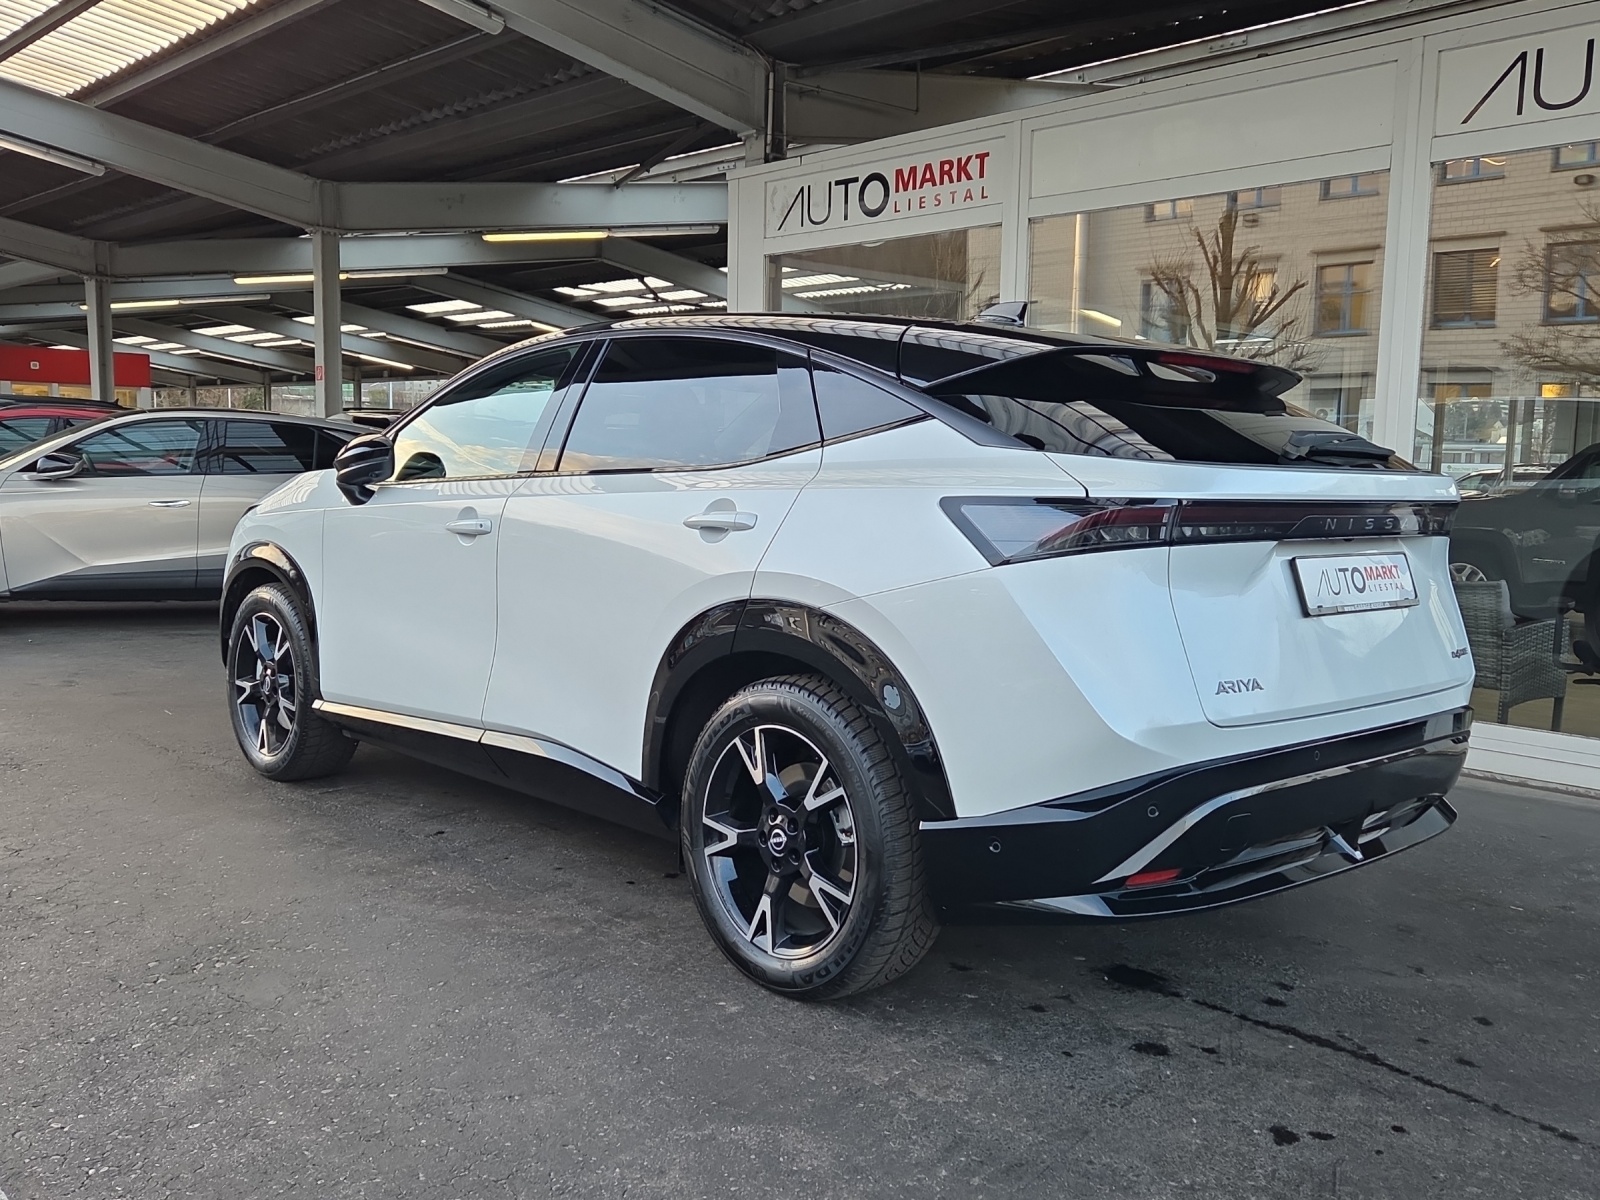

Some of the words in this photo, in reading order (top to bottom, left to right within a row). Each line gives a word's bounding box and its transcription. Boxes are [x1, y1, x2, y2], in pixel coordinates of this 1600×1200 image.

[1460, 38, 1595, 125] AU
[777, 172, 890, 231] AUTO
[894, 152, 990, 194] MARKT
[893, 186, 989, 213] LIESTAL
[1317, 566, 1367, 597] AUTO
[1363, 564, 1401, 581] MARKT
[1368, 582, 1405, 593] LIESTAL
[1215, 678, 1265, 695] ARIYA
